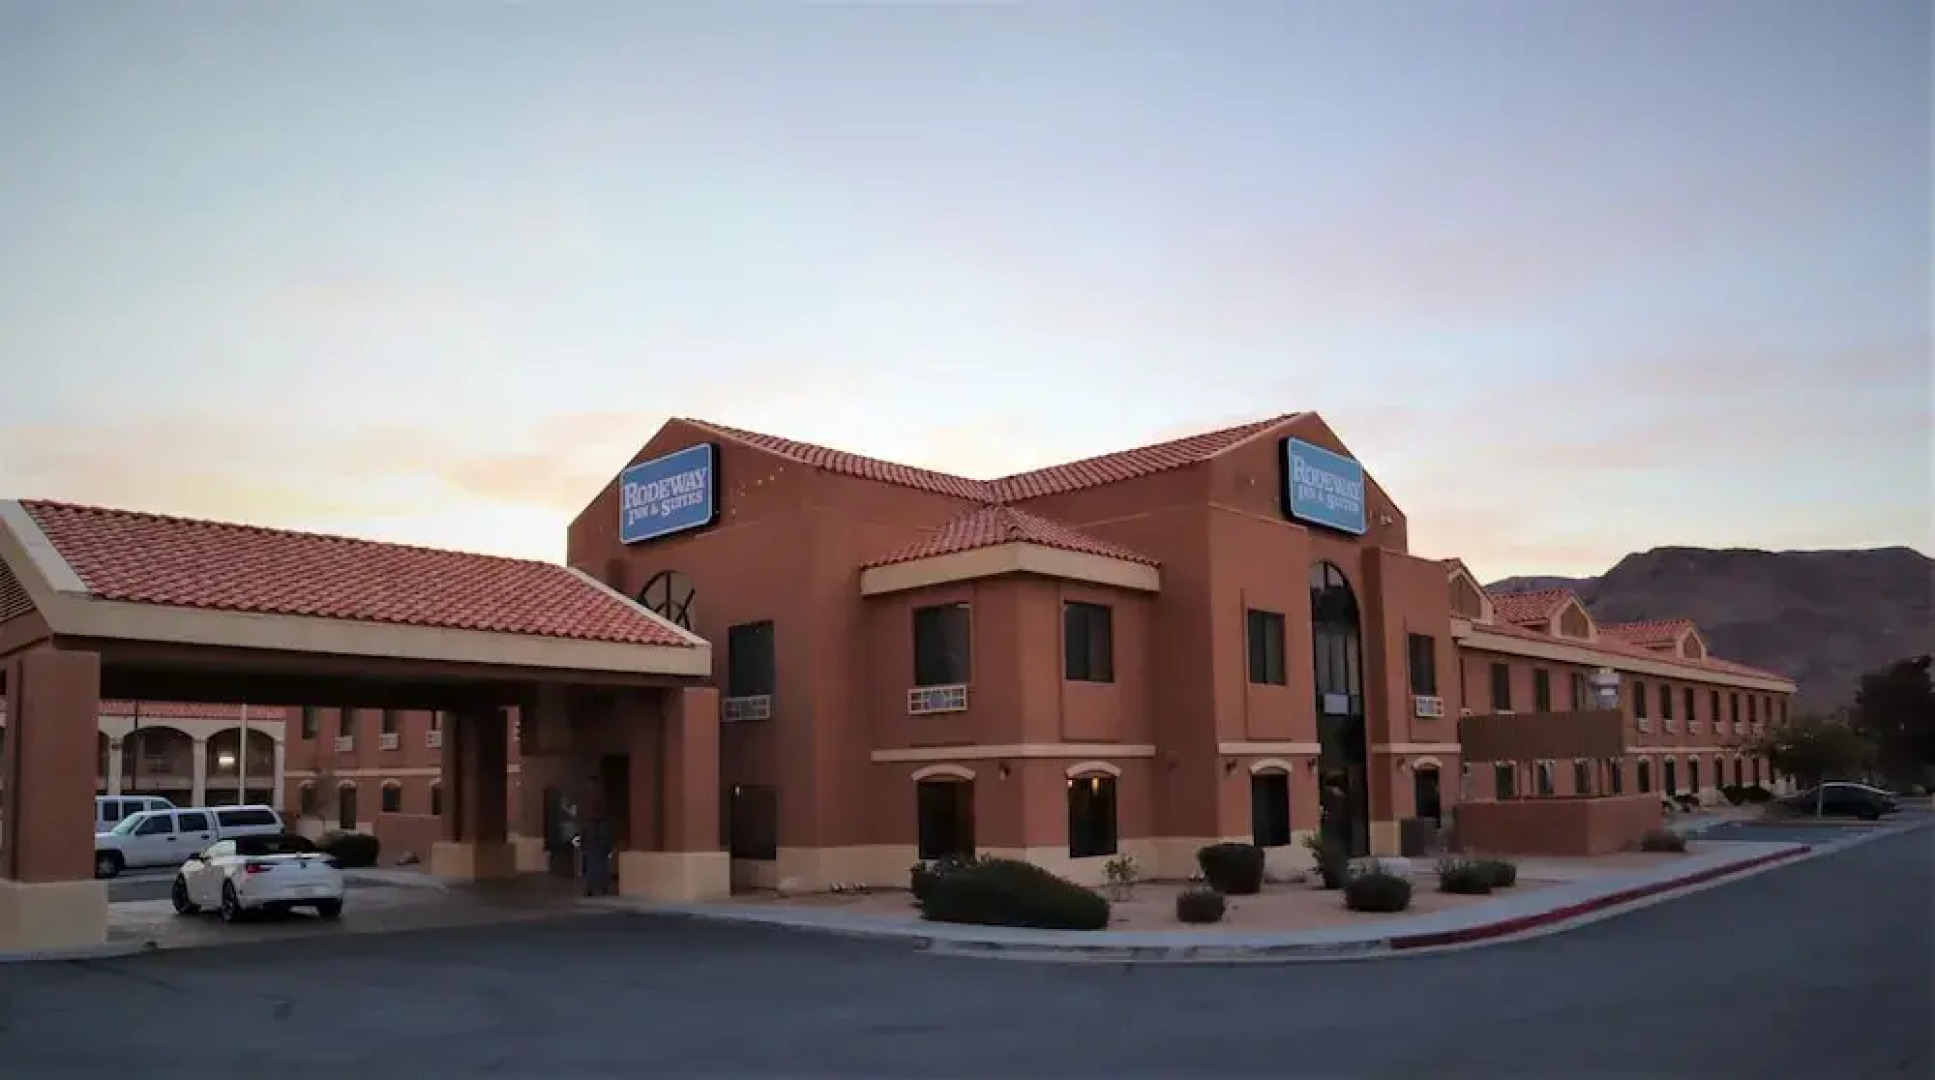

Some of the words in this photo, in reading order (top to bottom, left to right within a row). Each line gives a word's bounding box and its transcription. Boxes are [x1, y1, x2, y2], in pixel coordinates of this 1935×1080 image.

[624, 466, 707, 510] RODEWAY
[1293, 455, 1361, 500] RODEWAY
[628, 504, 649, 526] INN
[661, 489, 703, 517] SUITES
